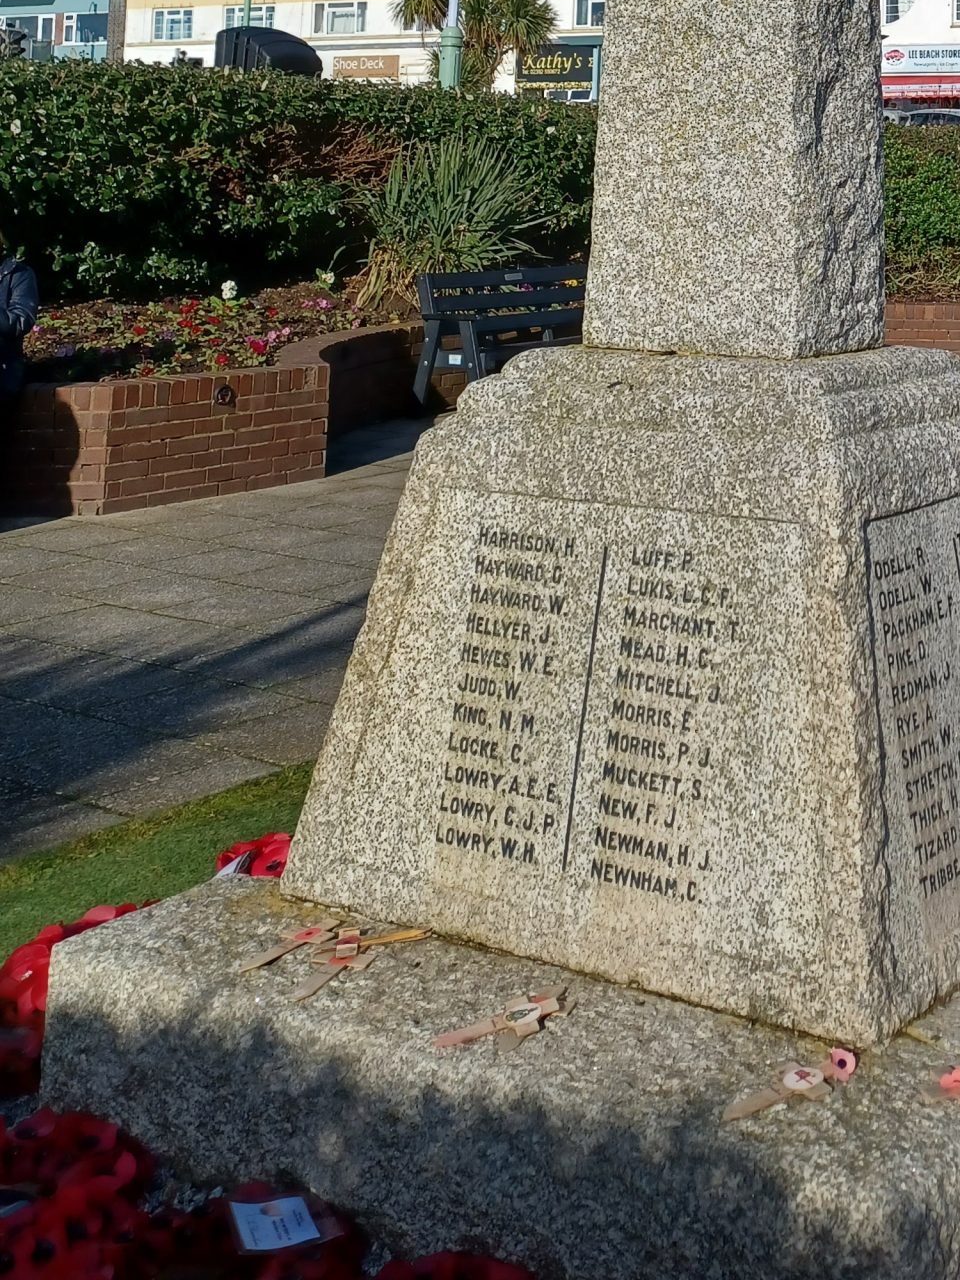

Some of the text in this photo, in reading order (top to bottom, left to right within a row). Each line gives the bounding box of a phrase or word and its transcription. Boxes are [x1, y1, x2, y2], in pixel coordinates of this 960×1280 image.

[334, 56, 384, 69] Shoe Deck
[522, 51, 583, 74] Kathy's
[908, 50, 918, 59] LEE
[919, 49, 940, 58] BEACH
[941, 49, 960, 58] STORE
[479, 526, 559, 559] HARRISON,
[875, 554, 915, 580] ODELL,
[470, 584, 545, 616] HAYWARD,
[466, 612, 535, 645] HELLYER,
[461, 642, 515, 672] HEWES,
[620, 636, 669, 666] MEAD,
[888, 648, 917, 676] PIKE,
[458, 673, 502, 701] JUDD,
[616, 665, 698, 703] MITCHELL,
[892, 669, 942, 707] REDMAN,
[453, 702, 491, 731] KING,
[611, 699, 675, 734] MORRIS,
[897, 712, 925, 739] RYE,
[606, 729, 671, 765] MORRIS,
[902, 736, 939, 769] SMITH,
[445, 762, 506, 797] LOWRY,
[906, 759, 957, 801] STRETCH,
[440, 792, 498, 827] LOWRY,
[599, 793, 640, 826] NEW,
[910, 800, 950, 834] THICK,
[436, 823, 496, 858] LOWRY,
[595, 826, 673, 868] NEWMAN,
[591, 858, 684, 902] NEWNHAM,
